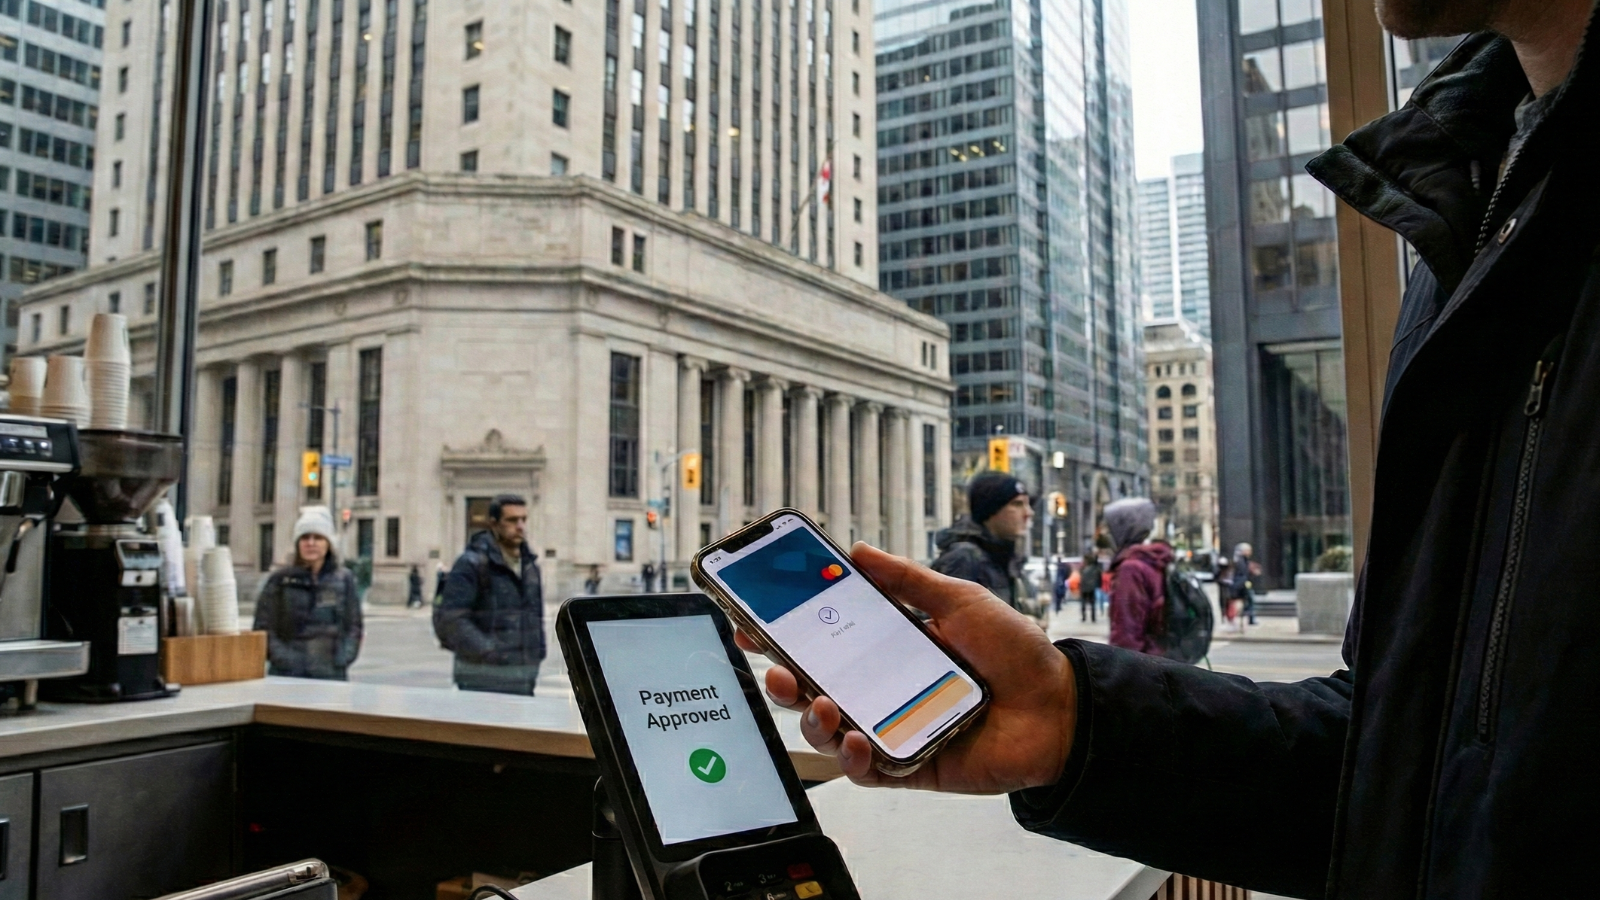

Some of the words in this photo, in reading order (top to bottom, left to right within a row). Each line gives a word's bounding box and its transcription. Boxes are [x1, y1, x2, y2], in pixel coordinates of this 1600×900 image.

[639, 685, 719, 707] Payment
[648, 704, 731, 731] Approved
[724, 881, 733, 892] 2
[758, 873, 767, 884] 3
